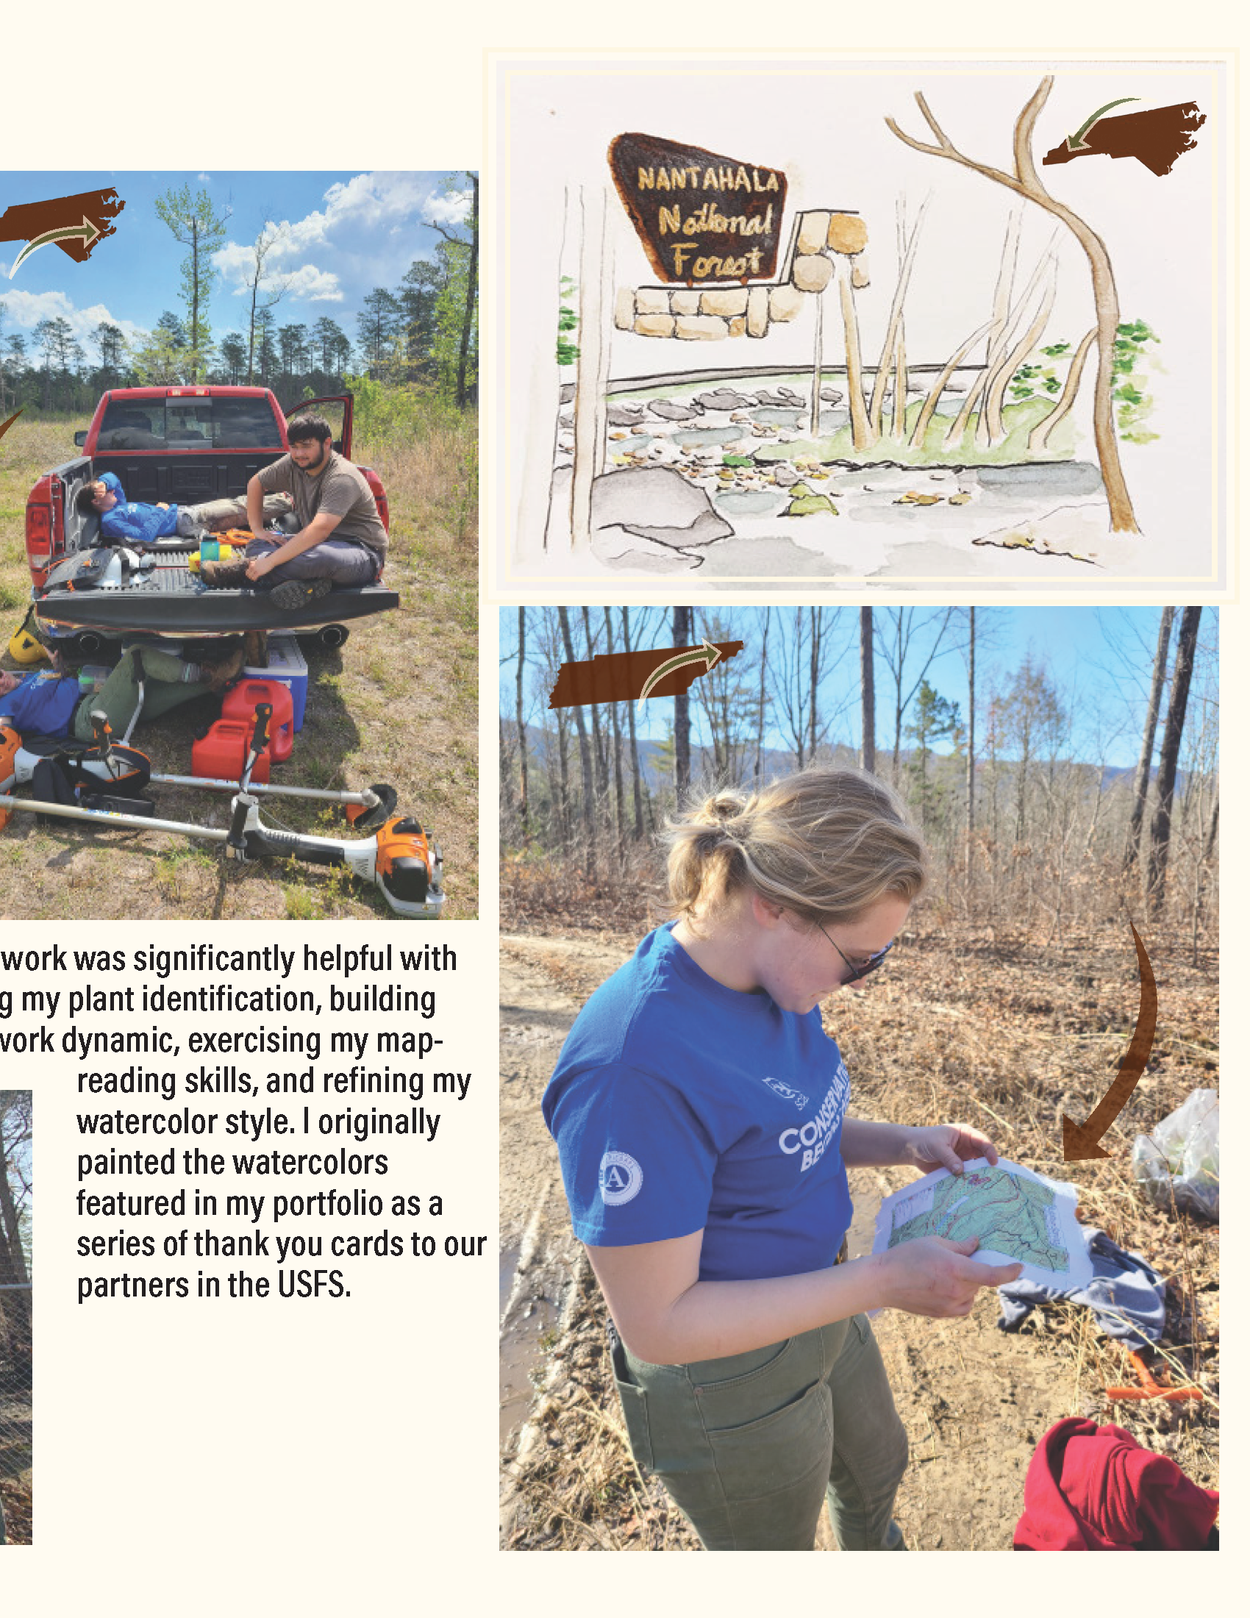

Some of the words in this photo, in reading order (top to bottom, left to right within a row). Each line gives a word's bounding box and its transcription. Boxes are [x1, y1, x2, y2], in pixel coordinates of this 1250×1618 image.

[637, 165, 780, 194] NANTAHALA
[658, 202, 773, 237] National
[670, 242, 765, 278] Forest
